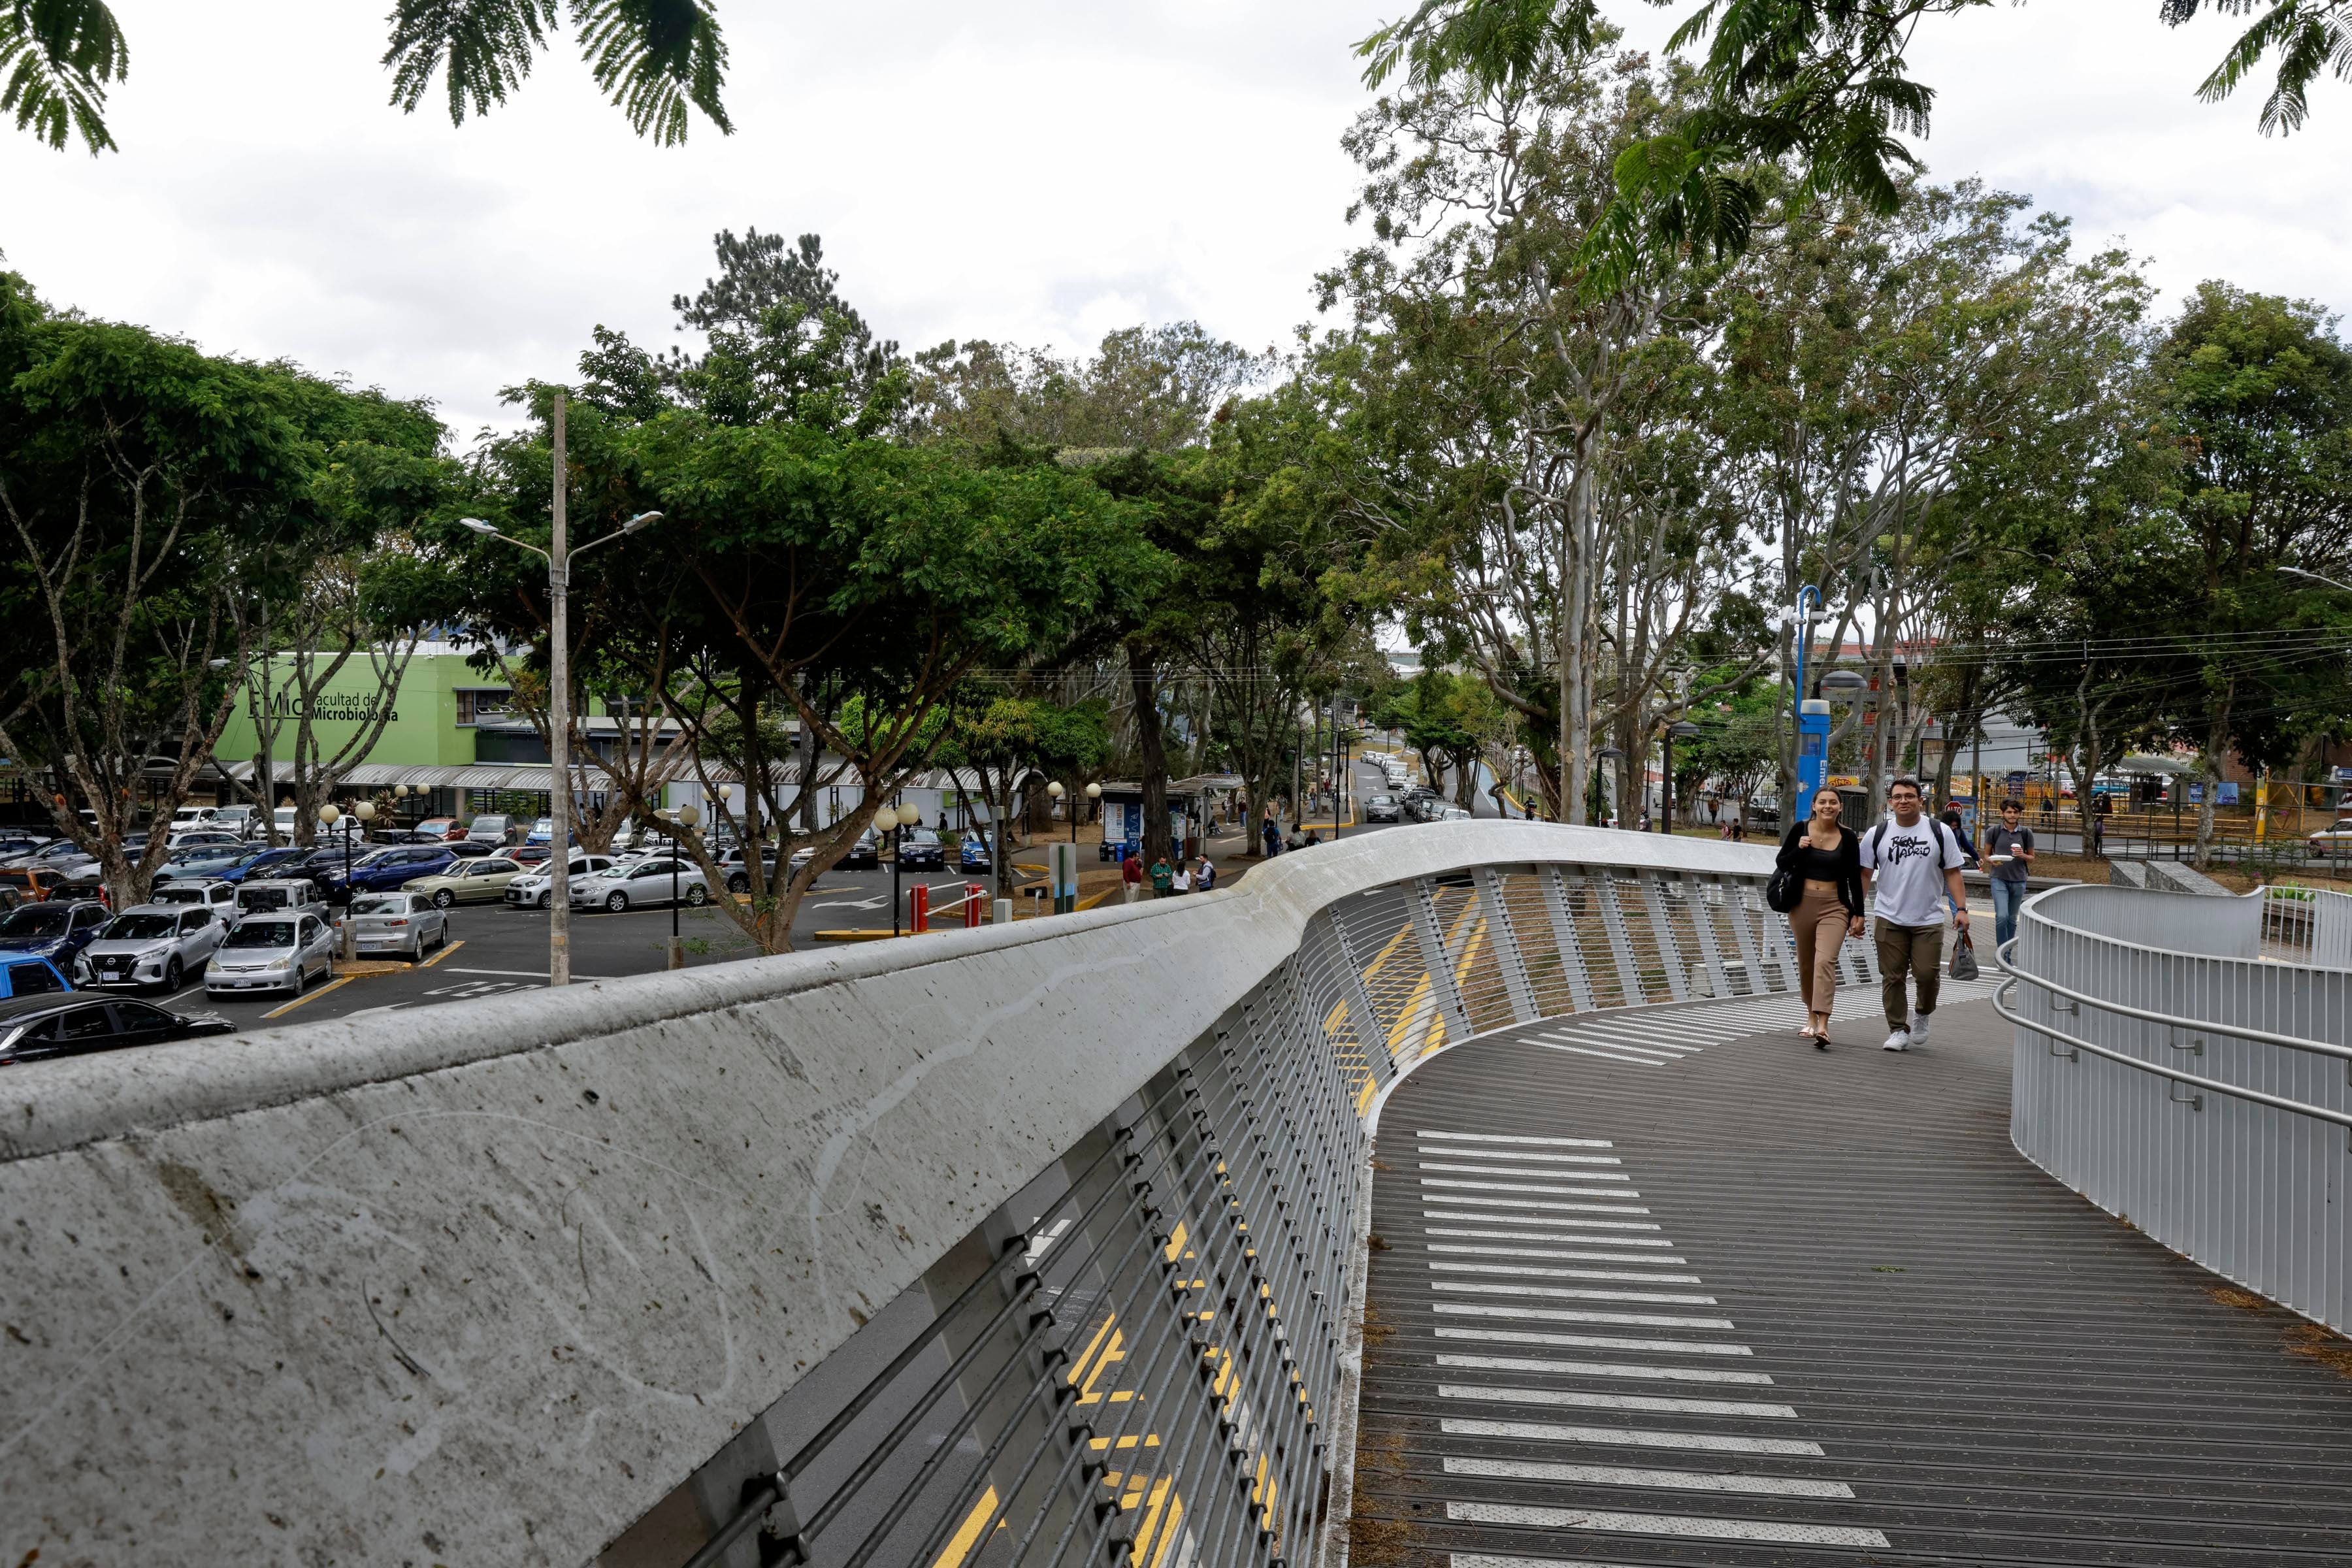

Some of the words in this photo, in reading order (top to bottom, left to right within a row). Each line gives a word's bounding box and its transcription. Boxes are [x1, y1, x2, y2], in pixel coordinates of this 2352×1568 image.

[313, 691, 359, 706] acultad
[363, 692, 377, 706] de
[312, 706, 398, 721] Microbioloa
[1890, 835, 1928, 848] REAL
